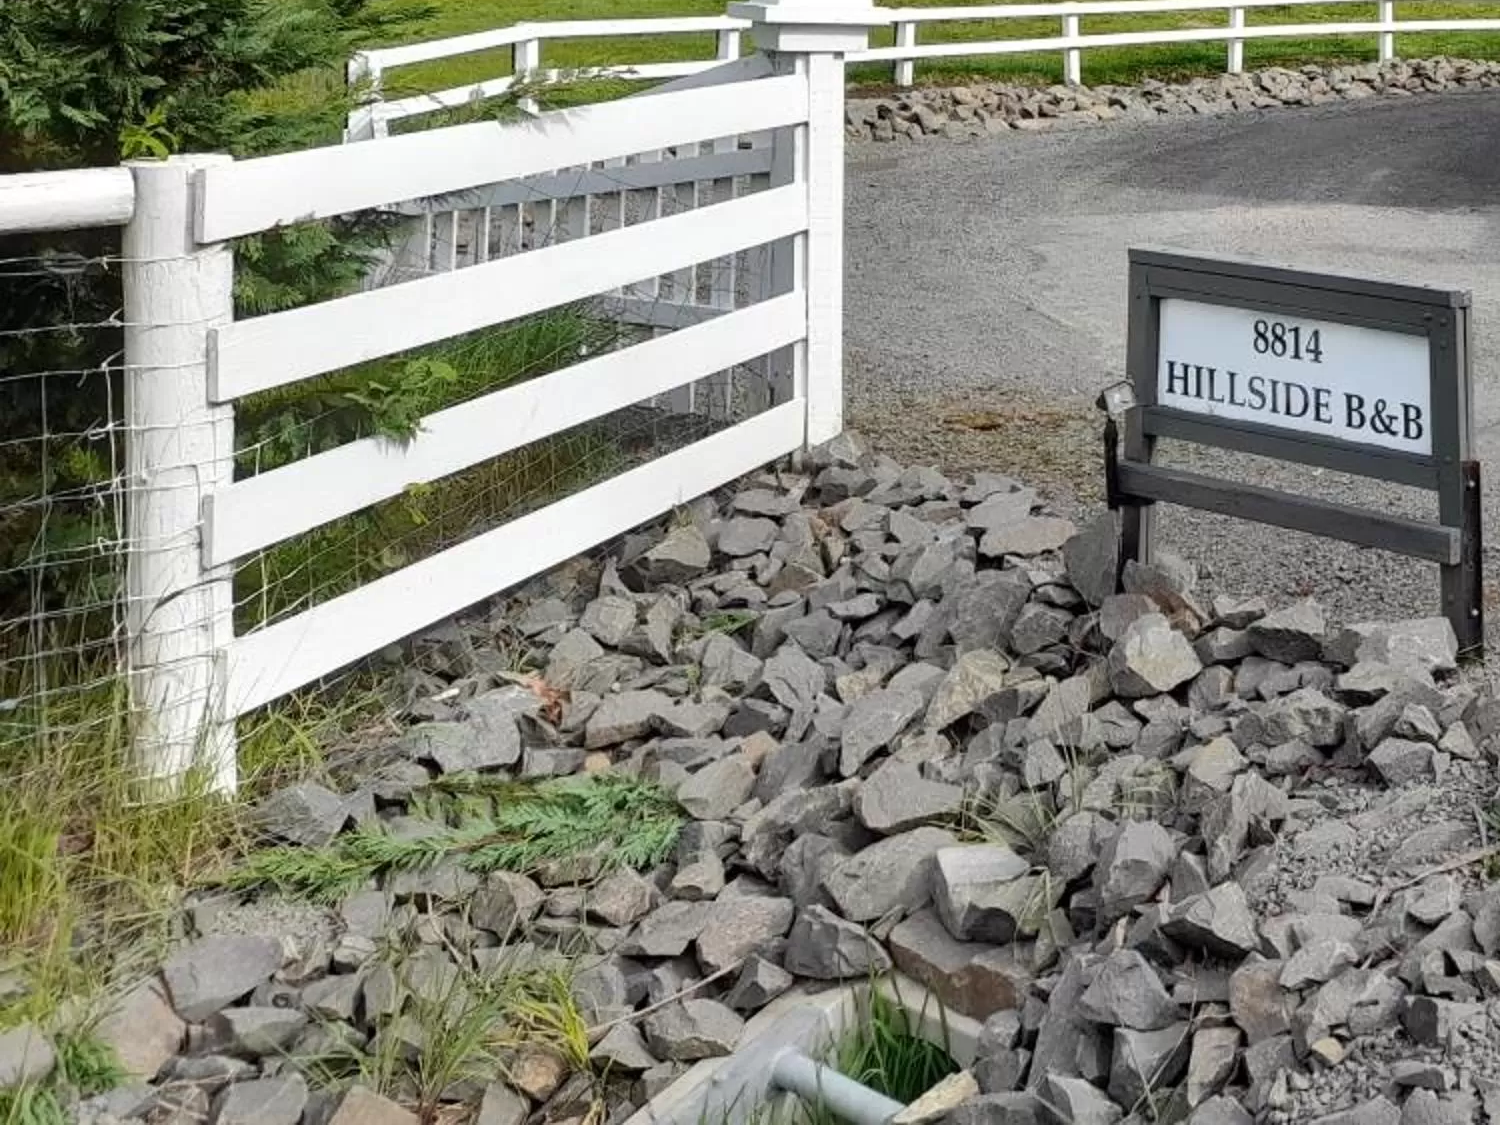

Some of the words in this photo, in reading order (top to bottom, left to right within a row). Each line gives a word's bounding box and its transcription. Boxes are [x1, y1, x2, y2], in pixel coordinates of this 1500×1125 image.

[1254, 320, 1323, 363] 8814
[1166, 360, 1333, 424] HILLSIDE
[1344, 393, 1423, 440] B&B
